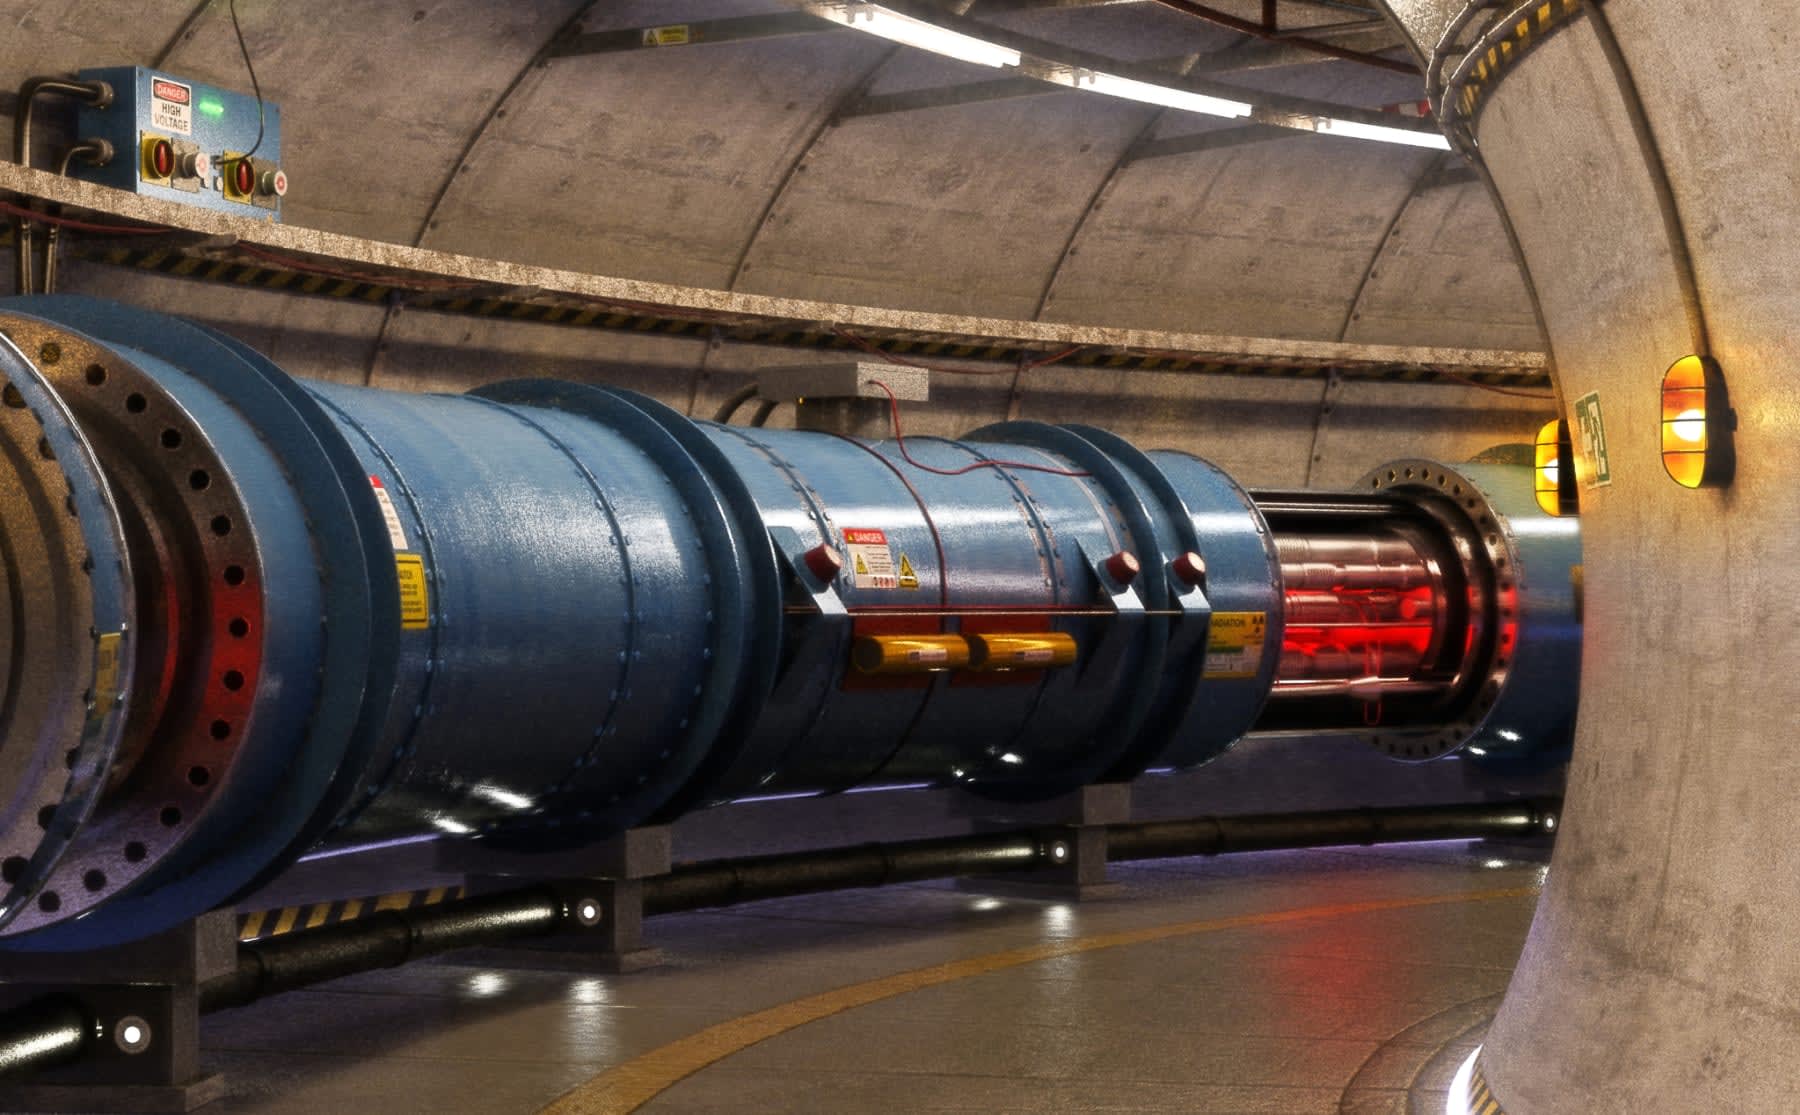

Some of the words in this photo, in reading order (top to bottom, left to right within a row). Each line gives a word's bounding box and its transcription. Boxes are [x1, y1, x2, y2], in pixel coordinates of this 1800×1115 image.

[157, 85, 187, 100] DANGER
[162, 103, 181, 117] HIGH
[154, 112, 188, 131] VOLTAGE
[854, 532, 883, 542] DANGER
